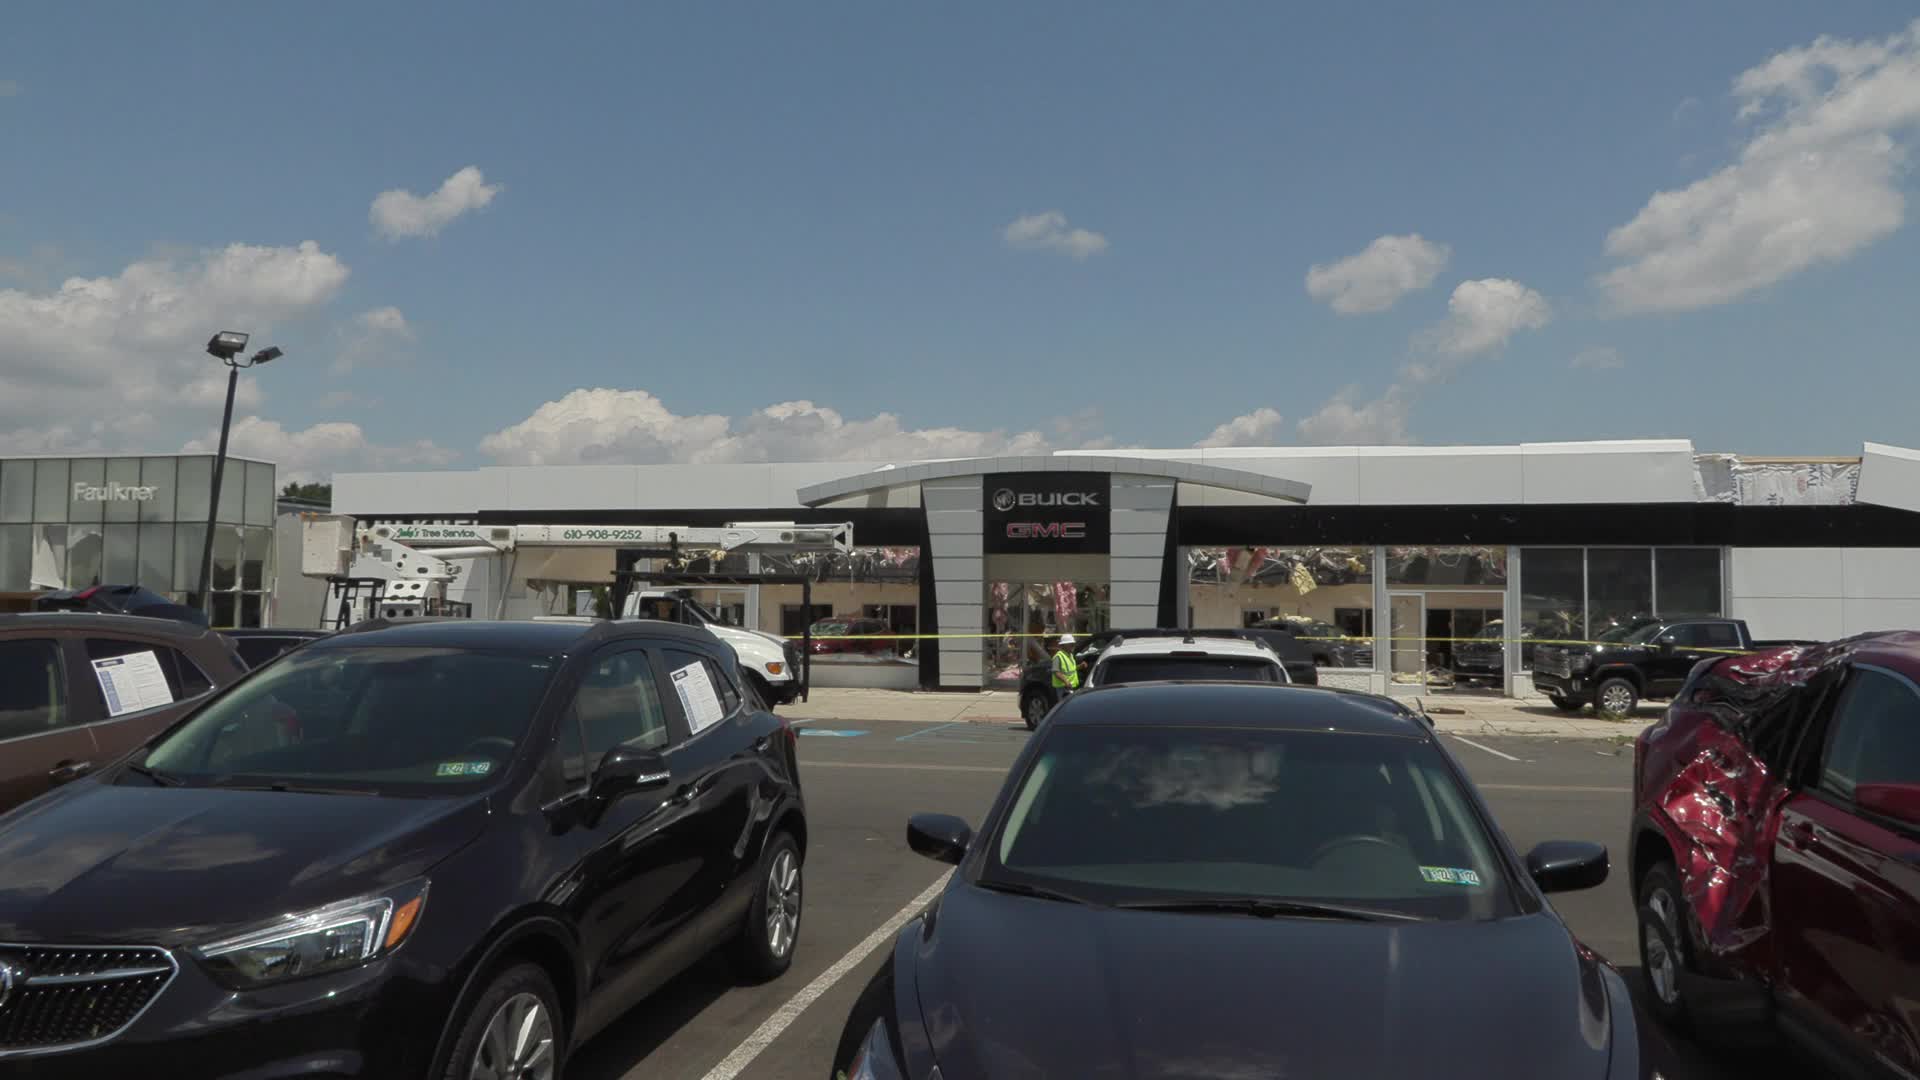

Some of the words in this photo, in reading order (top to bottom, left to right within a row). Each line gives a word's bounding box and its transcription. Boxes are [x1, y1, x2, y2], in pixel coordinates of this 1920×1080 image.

[73, 482, 159, 501] Faulkner
[1018, 492, 1099, 506] BUICK
[421, 528, 441, 538] Tree
[442, 528, 476, 538] Service
[563, 529, 642, 540] 610-908-9252
[1007, 522, 1086, 538] GMC
